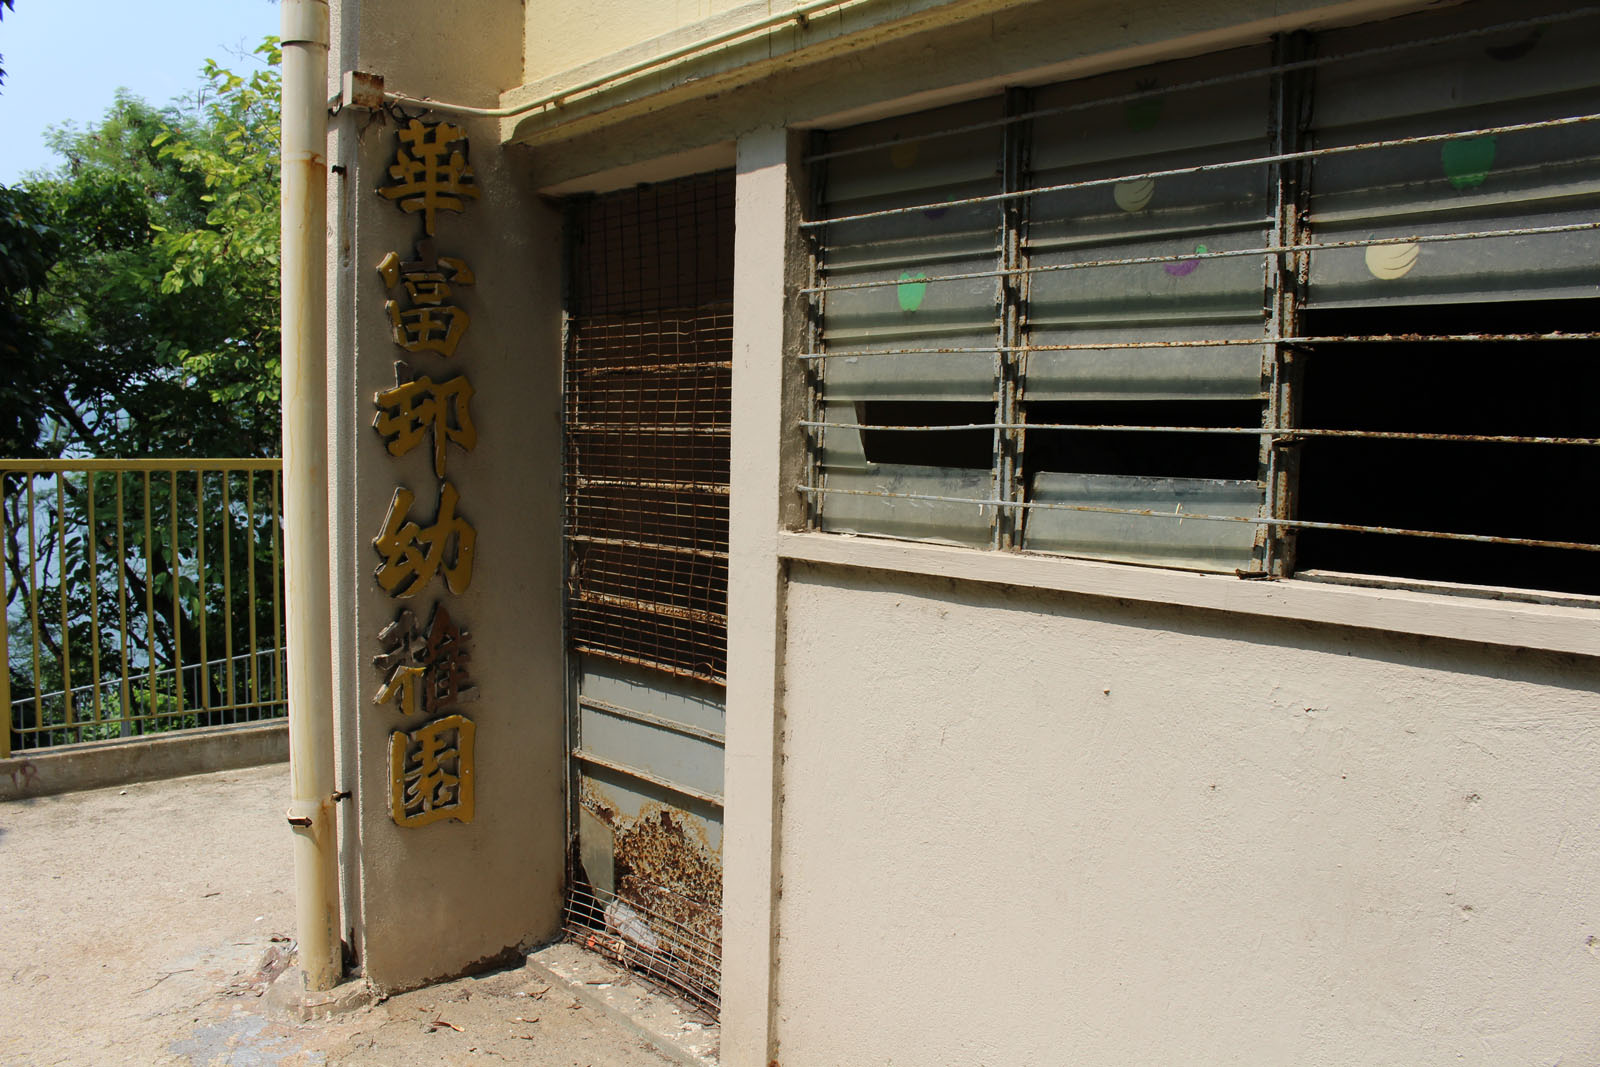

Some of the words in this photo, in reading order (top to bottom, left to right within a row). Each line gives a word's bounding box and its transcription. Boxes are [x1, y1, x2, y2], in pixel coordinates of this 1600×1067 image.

[372, 119, 480, 828] 華富邨幼稚園
